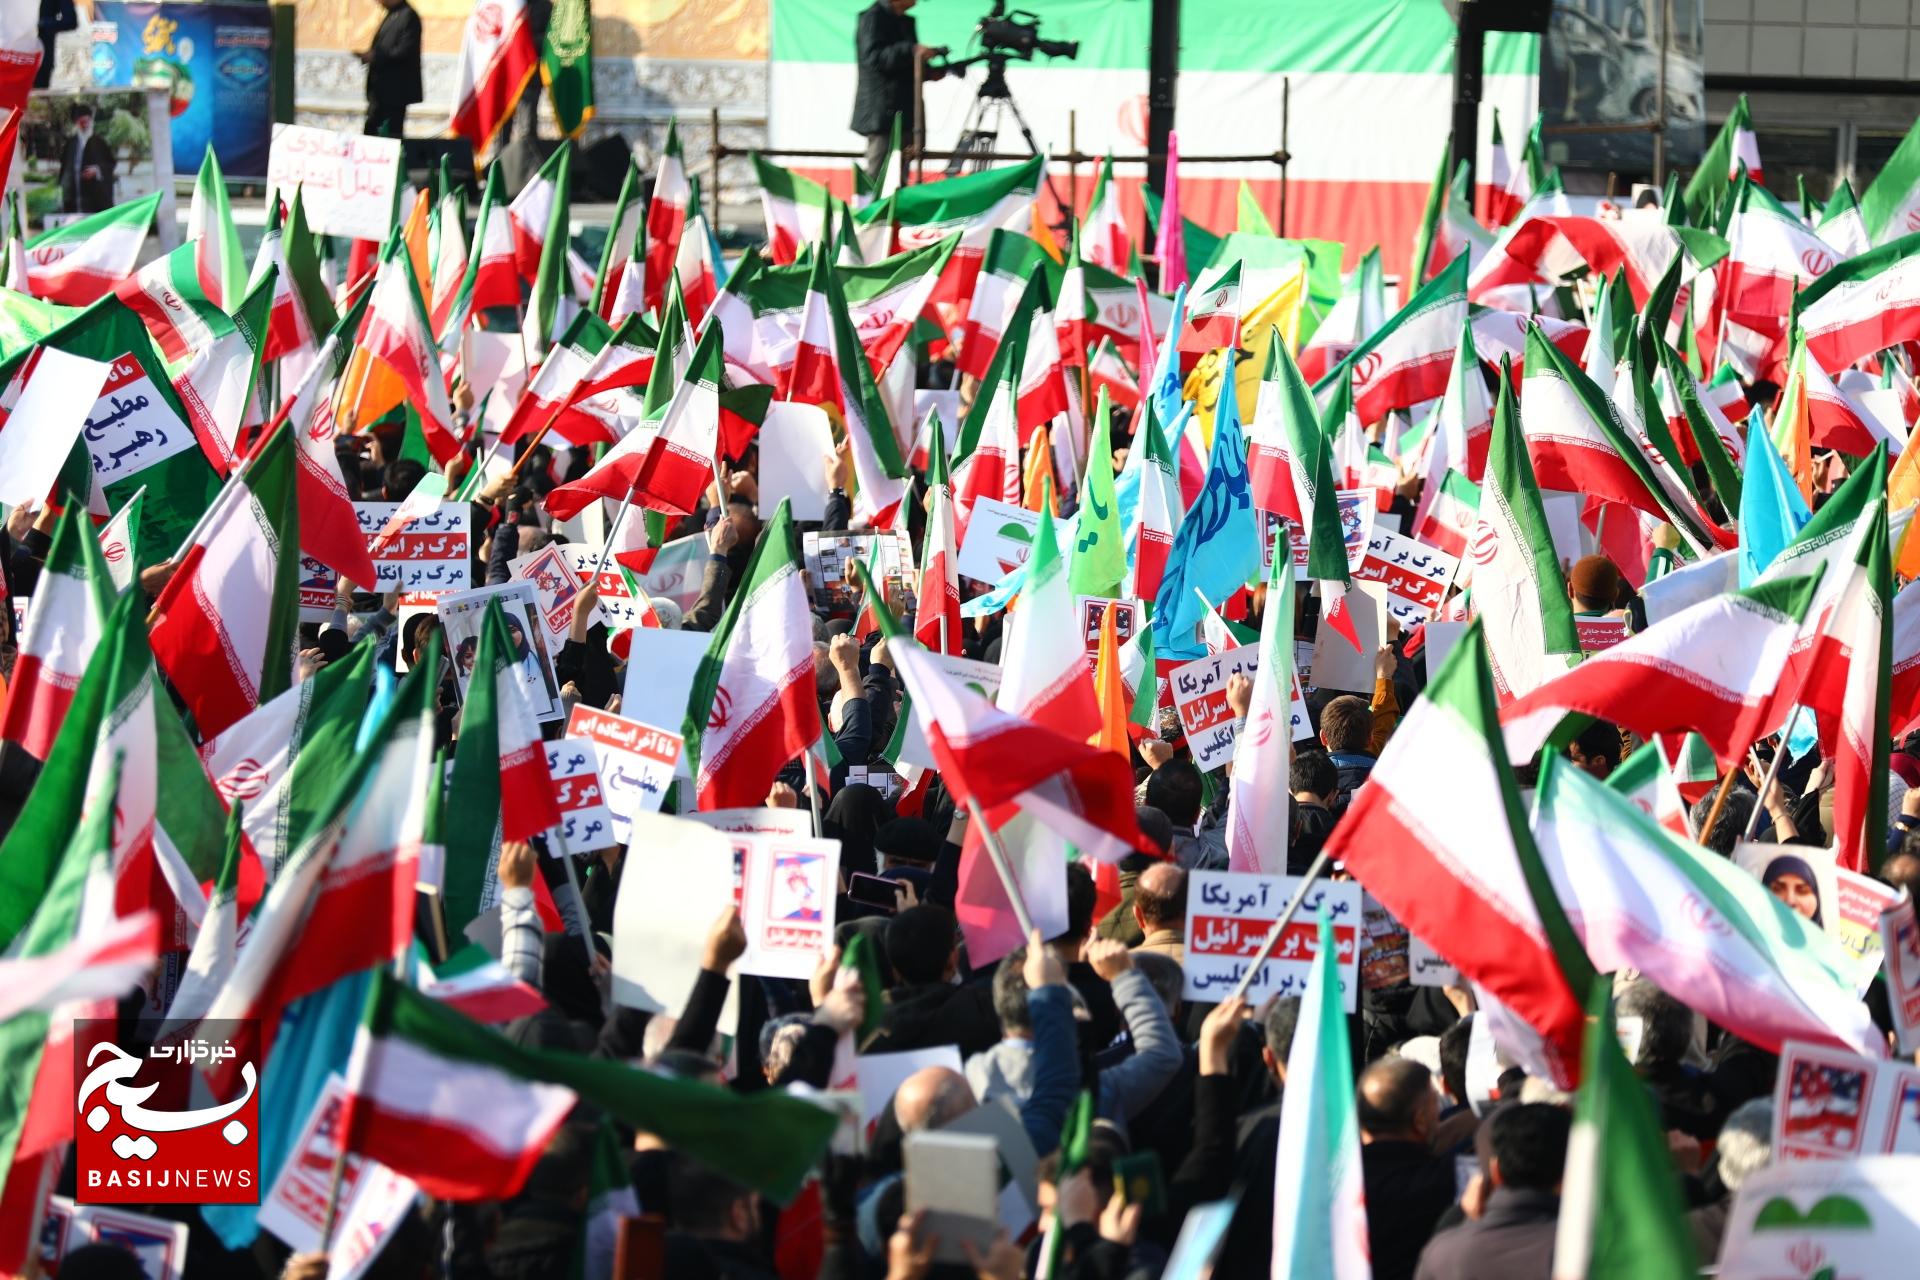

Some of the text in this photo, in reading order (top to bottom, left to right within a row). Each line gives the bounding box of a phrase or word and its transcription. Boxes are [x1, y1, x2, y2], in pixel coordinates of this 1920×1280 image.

[84, 395, 149, 441] مطیع
[425, 511, 462, 531] مرگ
[408, 541, 424, 558] بر
[428, 536, 466, 558] مرگ
[577, 555, 586, 570] بر
[1392, 551, 1409, 565] بر
[1411, 555, 1446, 578] مرگ
[407, 572, 421, 585] بر
[427, 565, 464, 584] مرگ
[600, 576, 626, 595] مرگ
[1387, 577, 1441, 604] مرگ بر
[610, 602, 635, 620] مرگ
[1178, 660, 1221, 695] آمریکا
[556, 781, 598, 807] مرگ
[1201, 883, 1271, 914] آمریکا
[1280, 932, 1300, 956] بر
